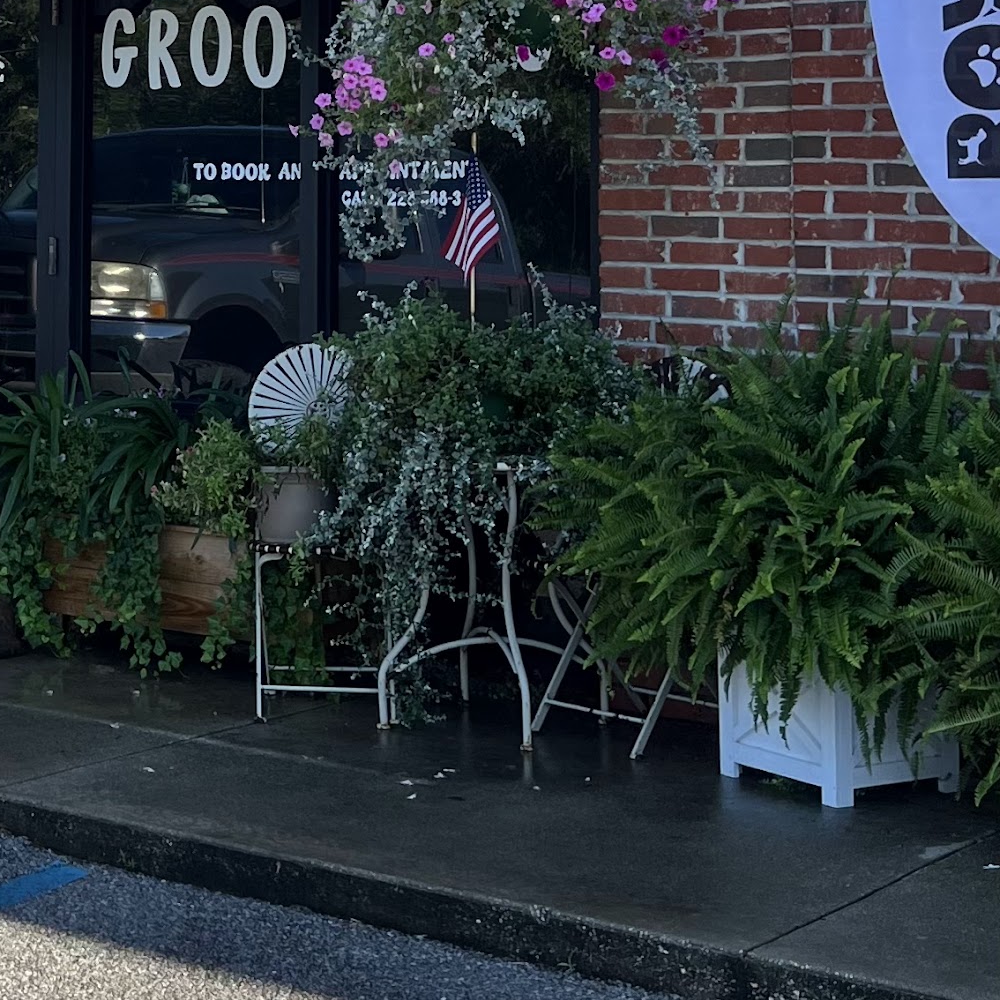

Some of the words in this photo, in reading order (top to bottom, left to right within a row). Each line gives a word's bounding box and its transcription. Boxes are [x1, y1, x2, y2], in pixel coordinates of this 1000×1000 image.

[193, 162, 217, 180] TO
[221, 161, 271, 181] BOOK
[278, 161, 301, 180] AN
